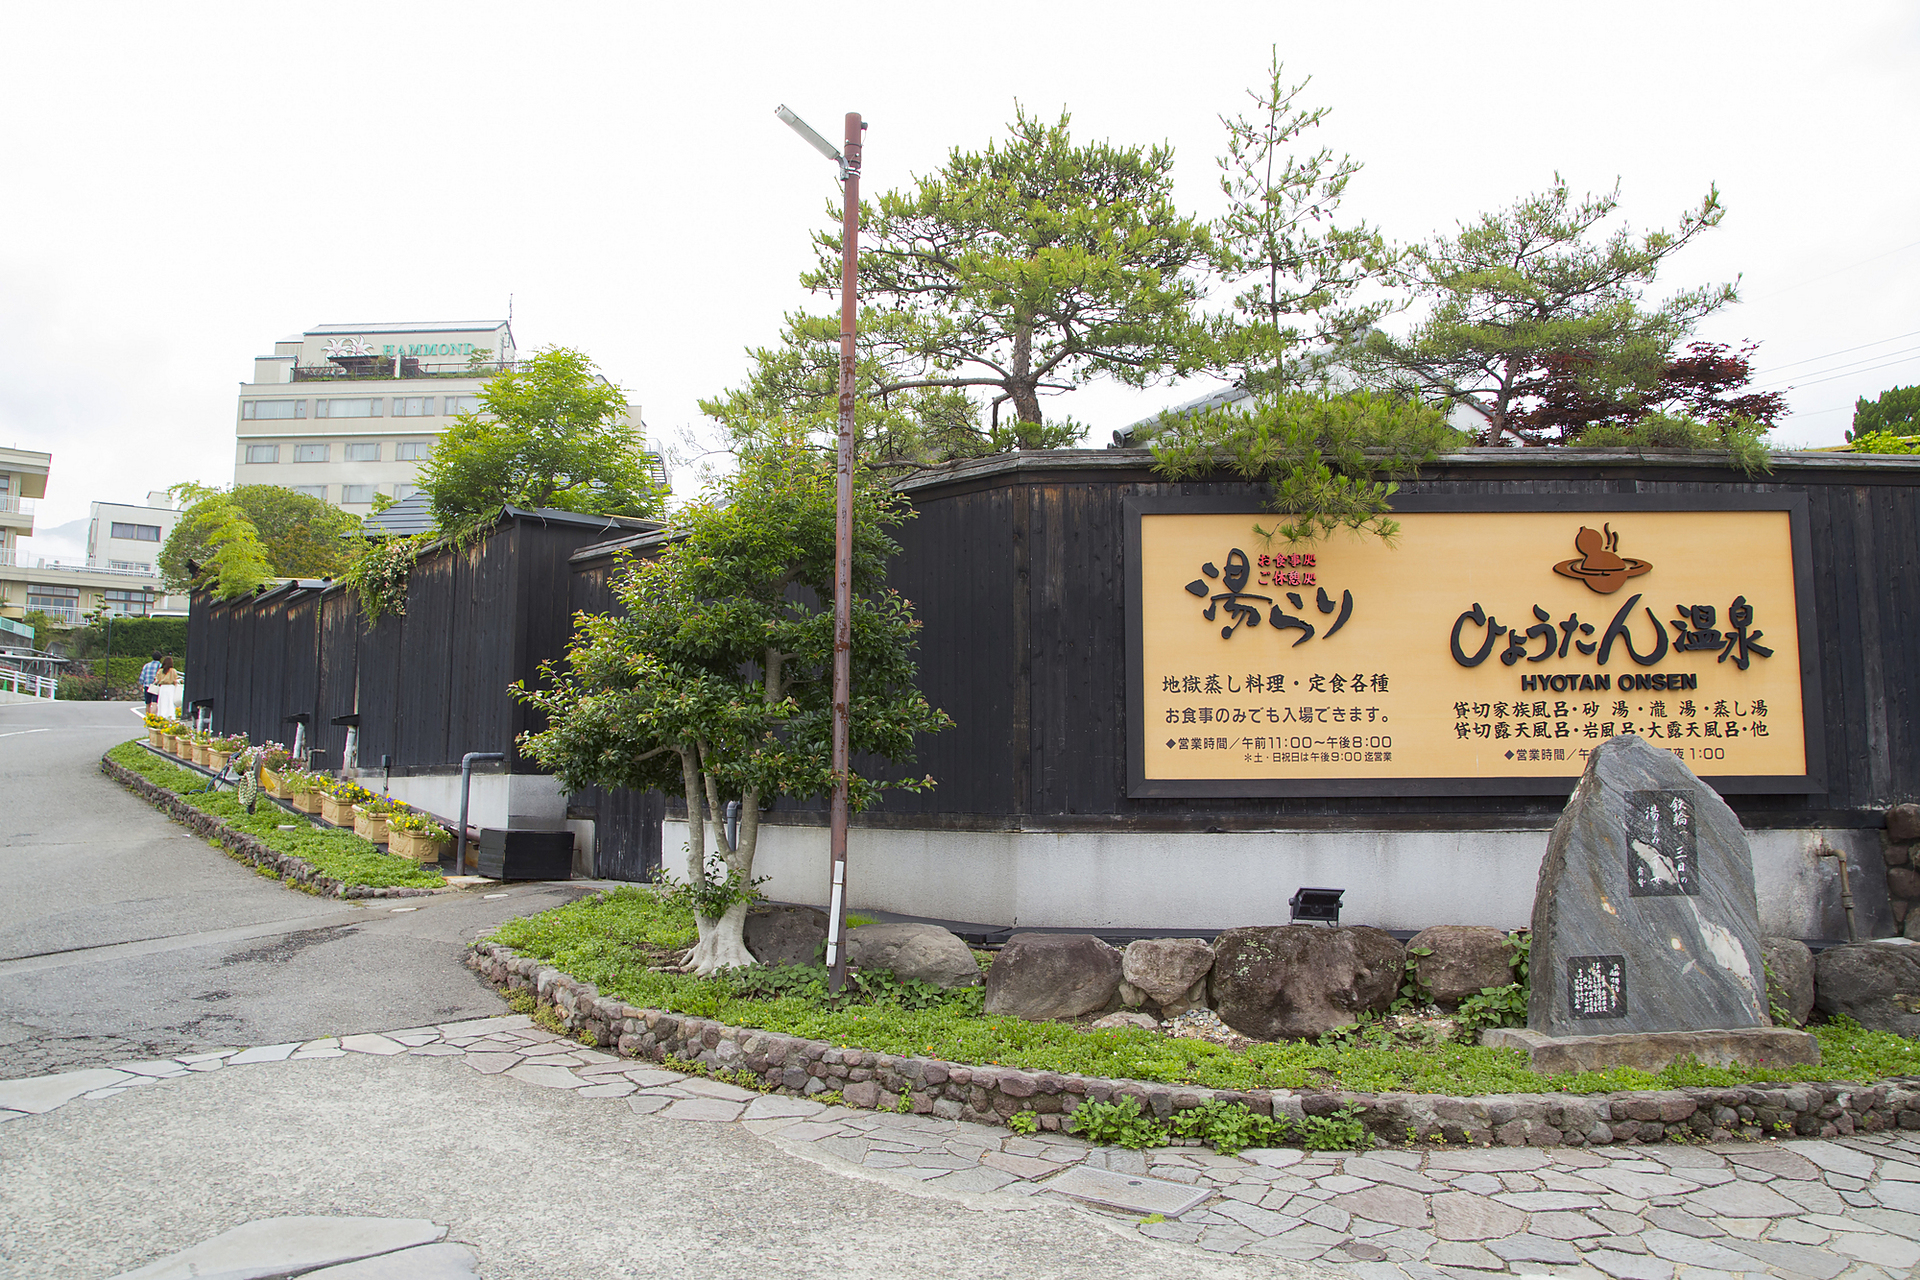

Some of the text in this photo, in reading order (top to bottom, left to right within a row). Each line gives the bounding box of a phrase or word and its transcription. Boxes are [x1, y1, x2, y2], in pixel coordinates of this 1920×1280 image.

[383, 343, 475, 357] HAMMOND
[1257, 552, 1317, 568] お食事処
[1258, 570, 1317, 586] ご休憩処
[1450, 593, 1775, 670] ひょうたん温泉
[1162, 673, 1390, 695] 地獄蒸し料理・定食各種
[1521, 673, 1698, 692] HYOTAN ONSEN
[1165, 706, 1390, 724] お食事のみでも入場できます。
